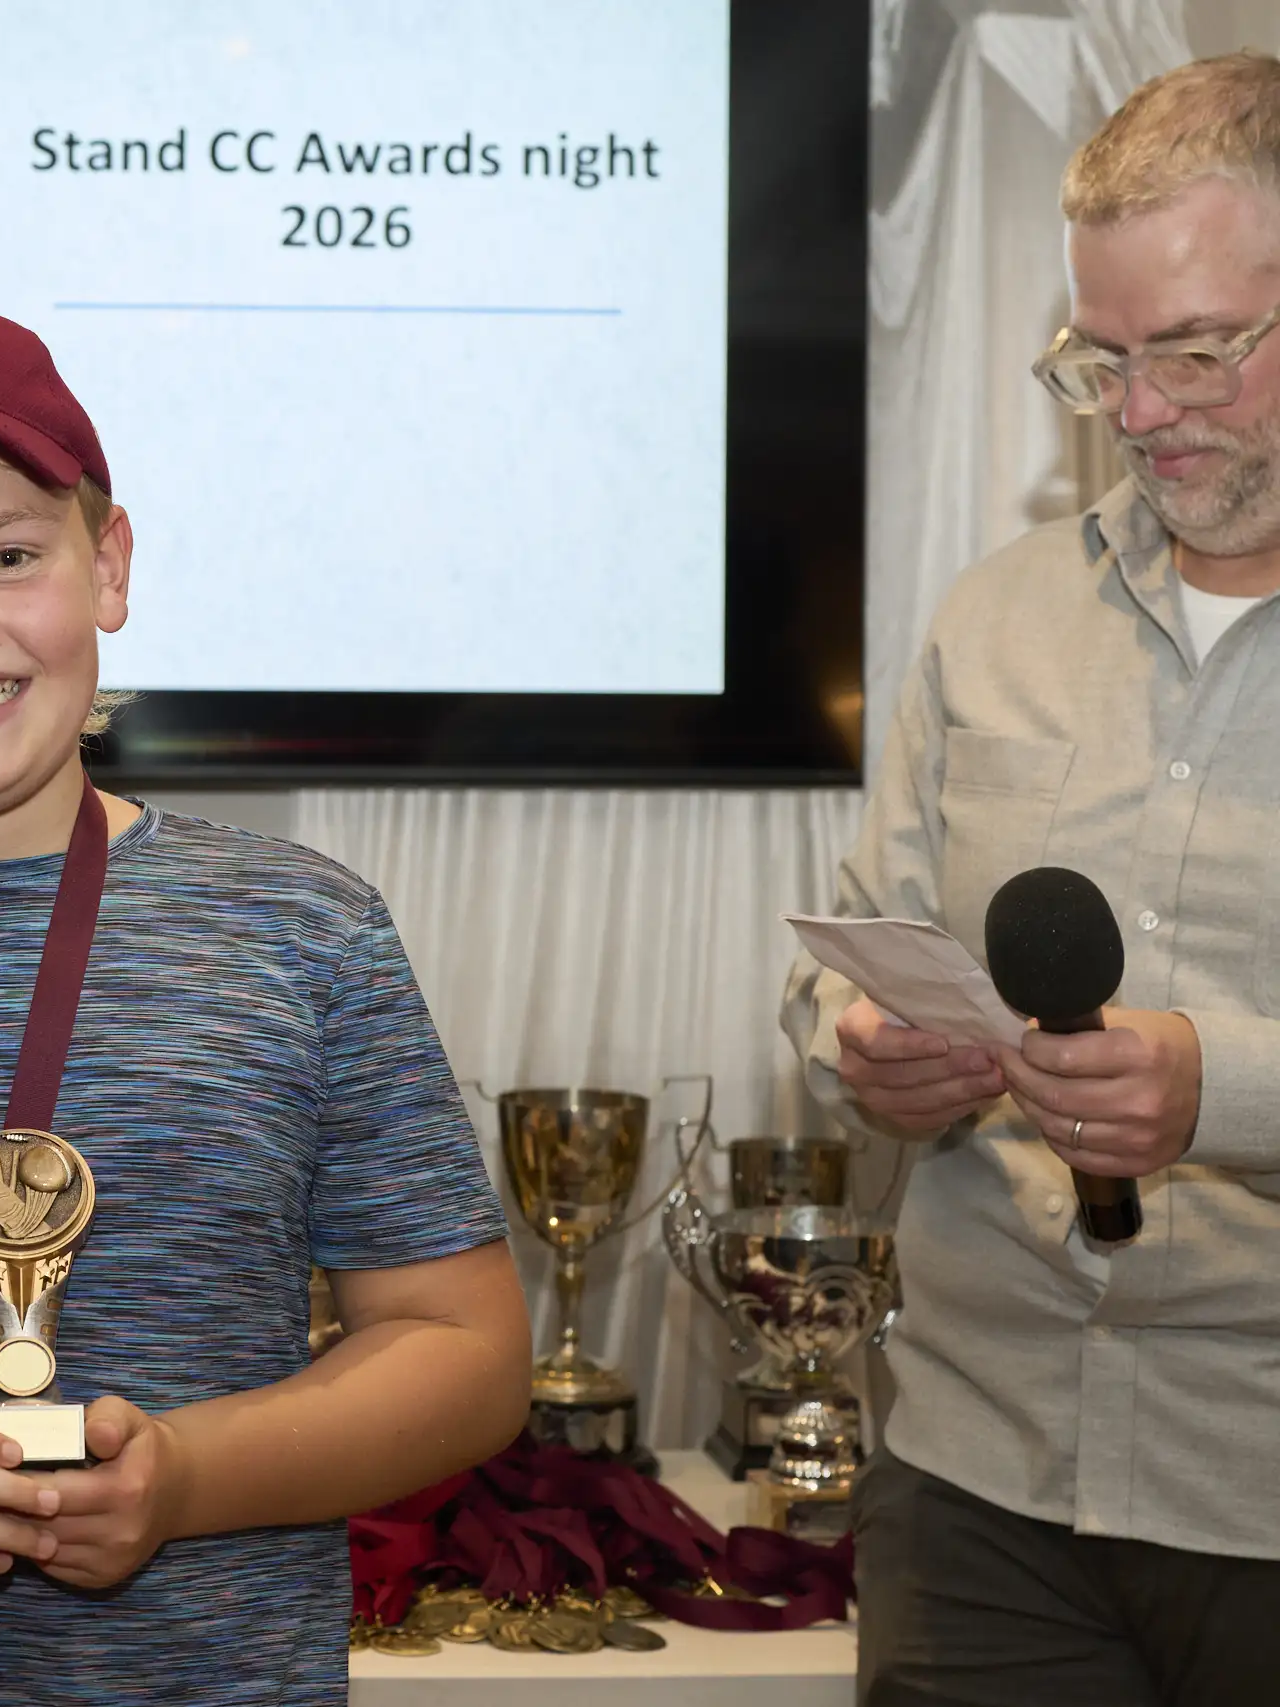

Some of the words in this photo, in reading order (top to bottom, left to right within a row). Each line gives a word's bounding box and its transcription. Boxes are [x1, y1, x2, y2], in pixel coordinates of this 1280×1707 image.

[32, 128, 186, 173] Stand
[210, 131, 276, 174] CC
[296, 131, 501, 176] Awards
[524, 133, 660, 189] night
[281, 205, 412, 248] 2026
